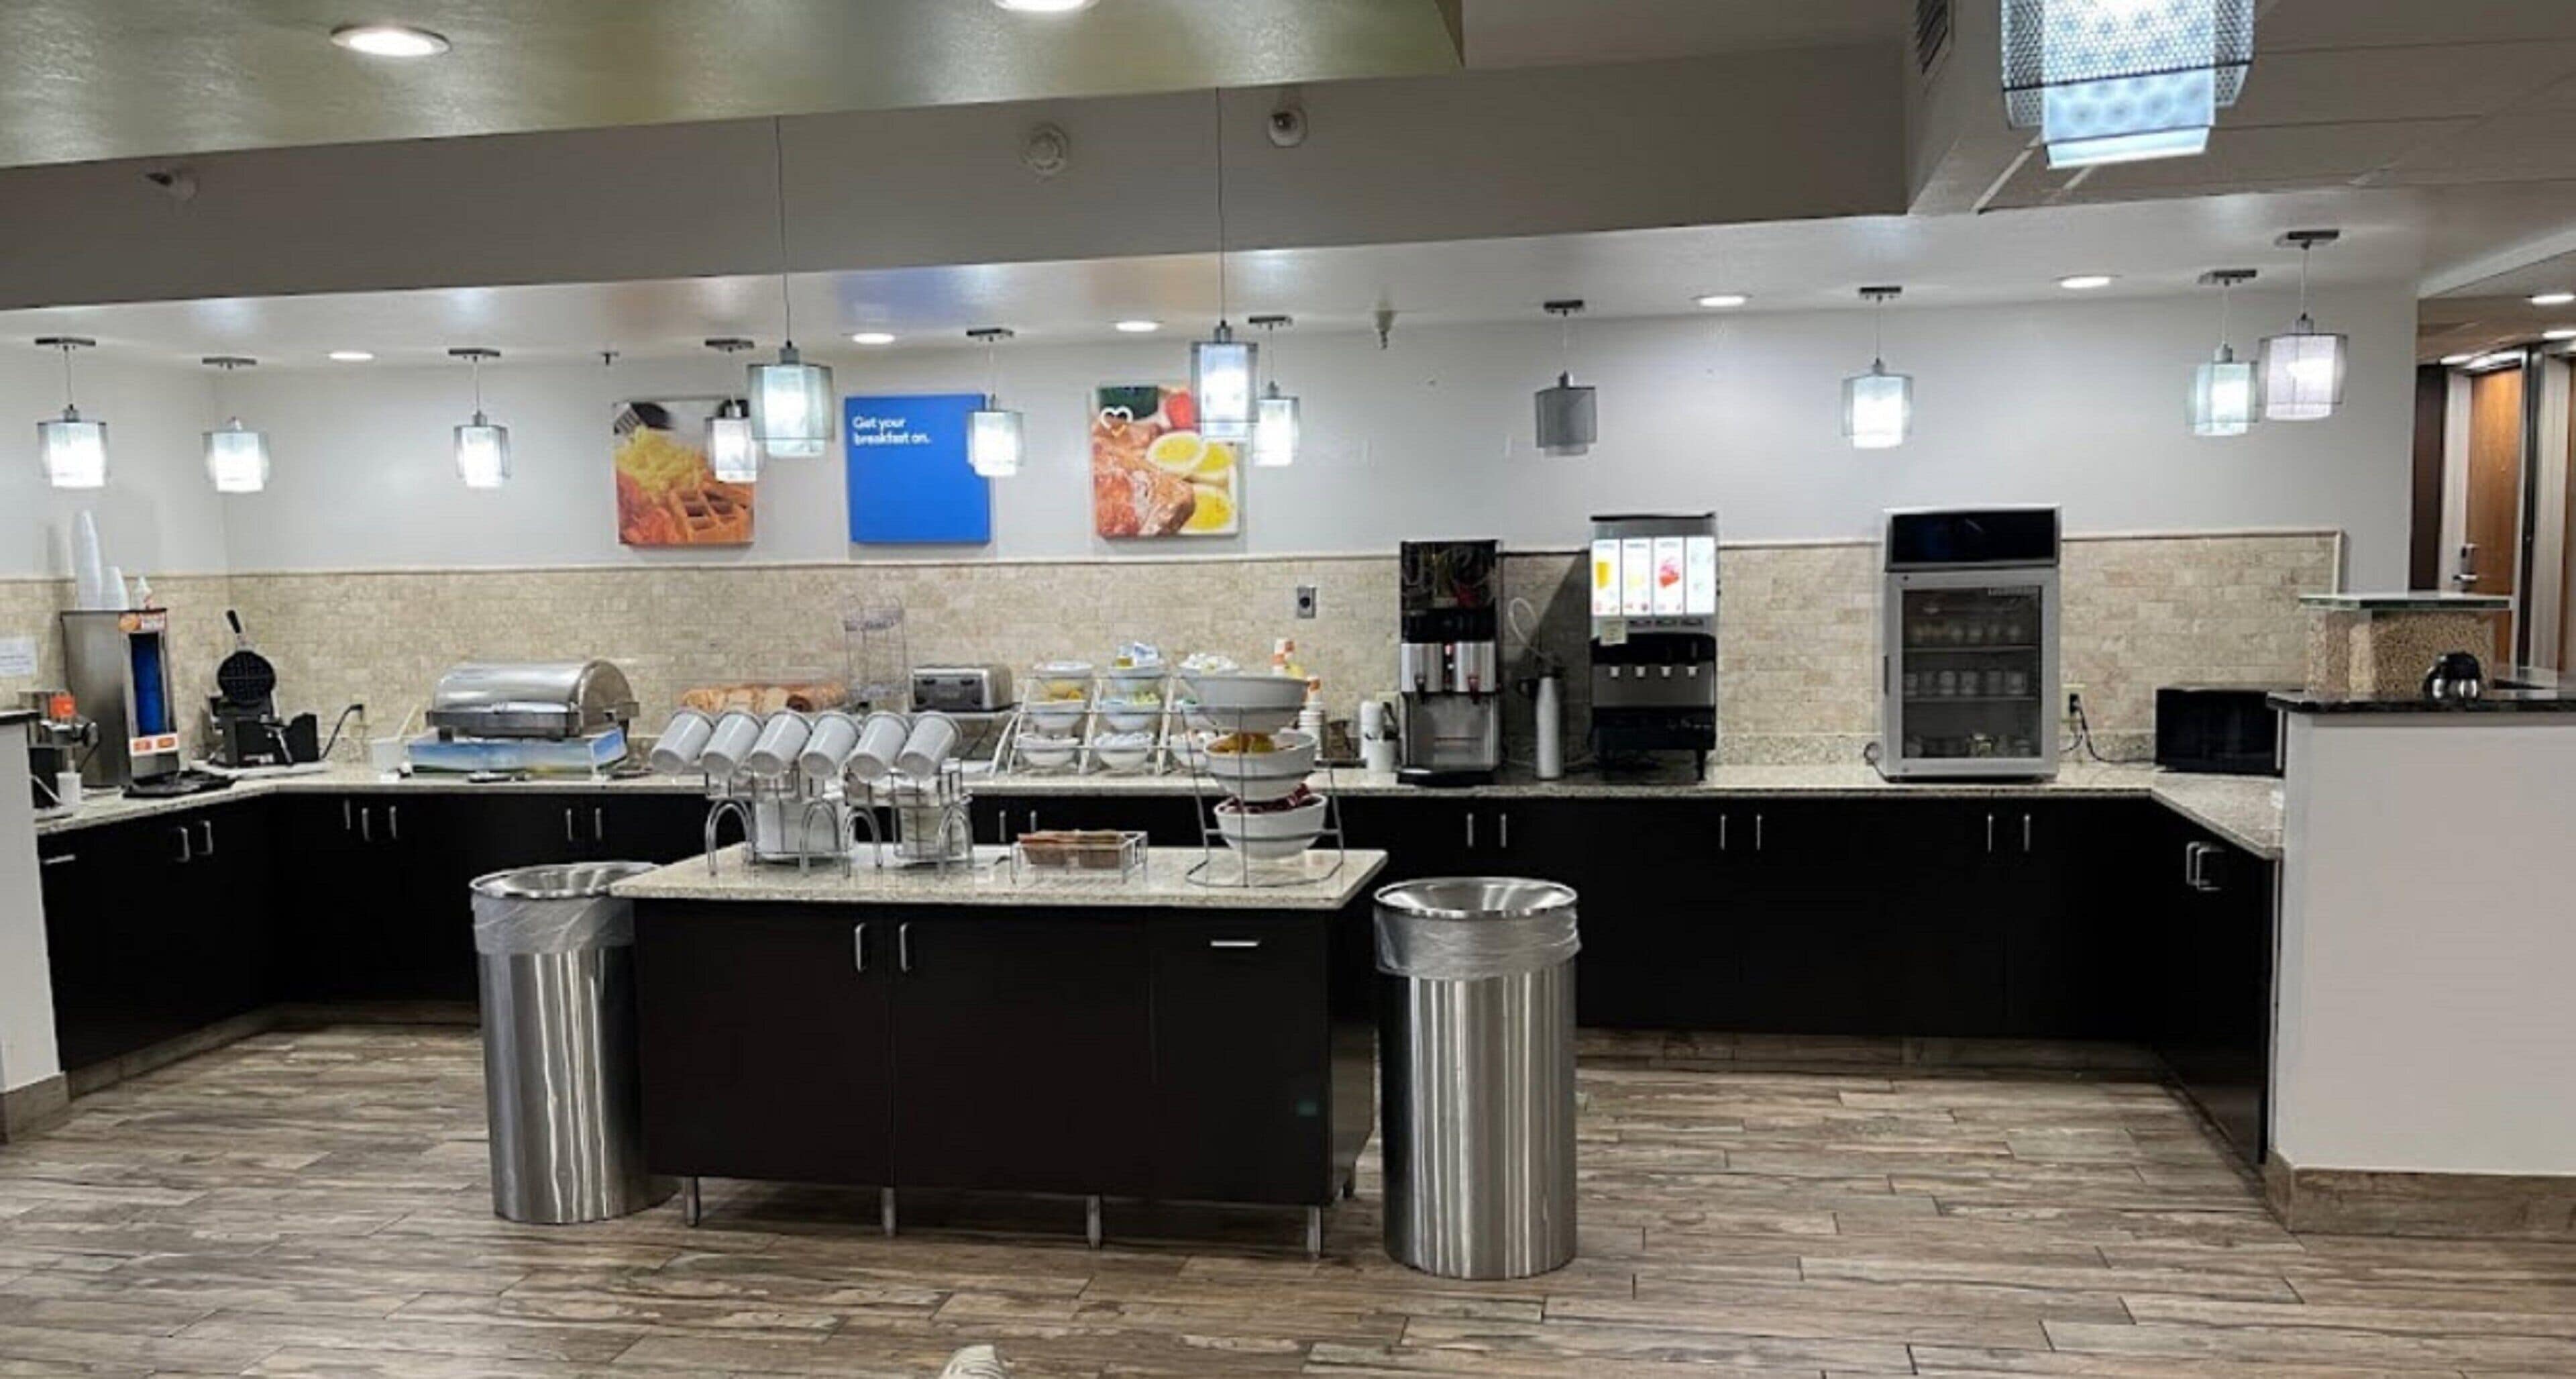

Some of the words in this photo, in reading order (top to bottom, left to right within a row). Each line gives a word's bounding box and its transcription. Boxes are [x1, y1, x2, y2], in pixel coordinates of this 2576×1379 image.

[852, 415, 876, 429] Get
[878, 417, 906, 435] your
[853, 431, 909, 446] breakfast
[911, 433, 931, 444] on.
